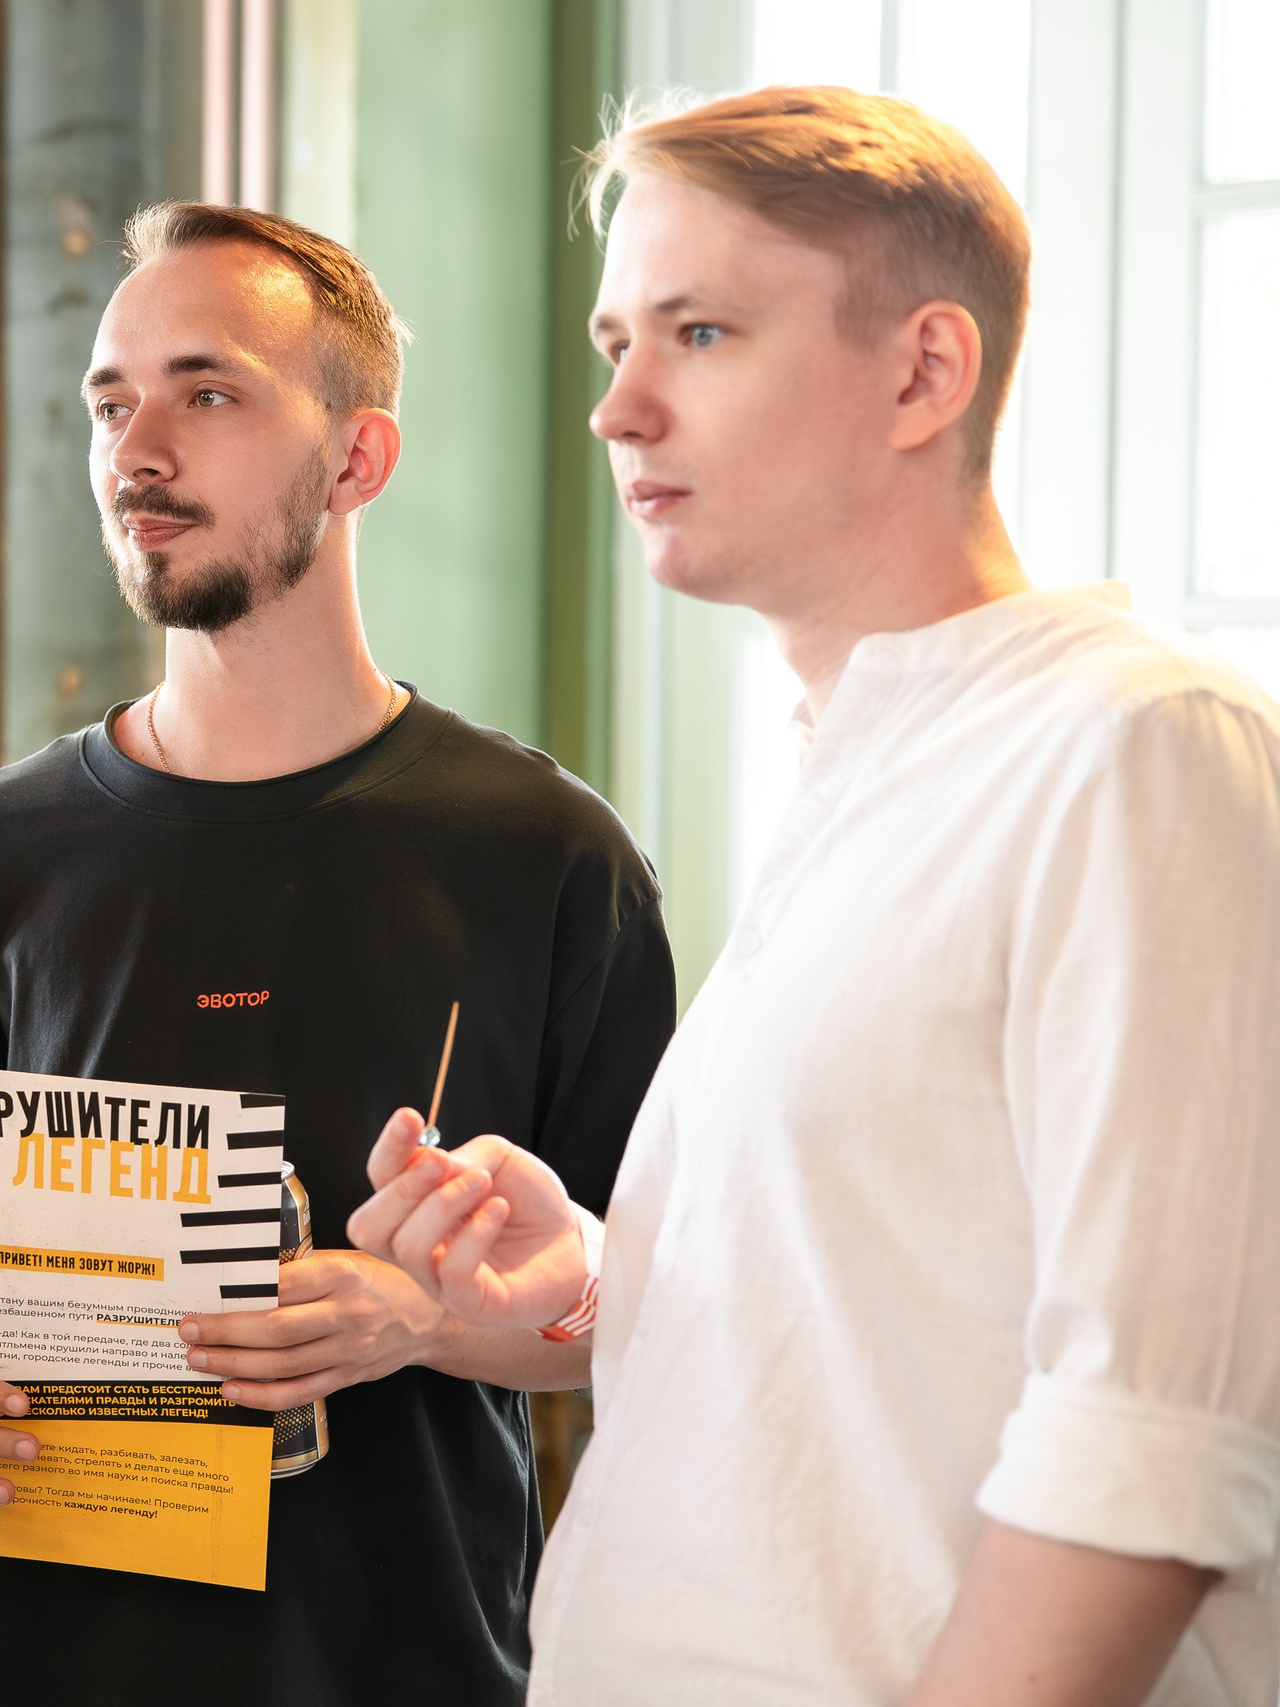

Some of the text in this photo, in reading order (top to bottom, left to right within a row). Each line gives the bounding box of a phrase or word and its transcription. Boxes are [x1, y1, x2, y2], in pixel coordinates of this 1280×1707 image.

[196, 990, 270, 1009] ЭВОТОР
[12, 1133, 211, 1204] ЛЕГЕНД
[46, 1255, 75, 1269] МЕНЯ
[79, 1257, 114, 1272] ЗОВУТ
[117, 1261, 155, 1276] ЖОРЖ!
[27, 1299, 64, 1308] вашим
[67, 1300, 124, 1312] безумным
[68, 1312, 94, 1321] пути
[96, 1313, 182, 1327] РАЗРУШИТЕЛЕ
[21, 1330, 40, 1339] Как
[52, 1333, 71, 1341] той
[73, 1334, 128, 1346] передаче,
[131, 1339, 149, 1347] где
[151, 1340, 171, 1349] два
[23, 1352, 81, 1363] городские
[83, 1357, 129, 1368] легенды
[142, 1362, 183, 1371] прочие
[49, 1344, 99, 1354] крушили
[102, 1347, 148, 1358] направо
[160, 1352, 187, 1360] нале
[43, 1385, 112, 1395] ПРЕДСТОИТ
[113, 1385, 150, 1394] СТАТЬ
[152, 1385, 222, 1395] БЕССТРАШН
[28, 1396, 236, 1407] КАТЕЛЯМИ ПРАВДЫ И РАЗГРОМИТЬ
[26, 1407, 209, 1419] ЕСКОЛЬКО ИЗВЕСТНЫХ ЛЕГЕНД!
[58, 1446, 98, 1455] кидать,
[100, 1448, 157, 1461] разбивать,
[160, 1454, 208, 1468] залезать,
[74, 1457, 122, 1469] стрелять
[133, 1463, 170, 1474] делать
[172, 1467, 195, 1477] еще
[197, 1471, 229, 1482] много
[22, 1464, 66, 1475] разного
[83, 1470, 104, 1478] имя
[107, 1471, 139, 1481] науки
[151, 1476, 188, 1488] поиска
[190, 1481, 234, 1495] правды!
[12, 1497, 158, 1519] рочность каждую легенду!
[14, 1485, 209, 1514] овы? Тогда мы начинаем! Проверим
